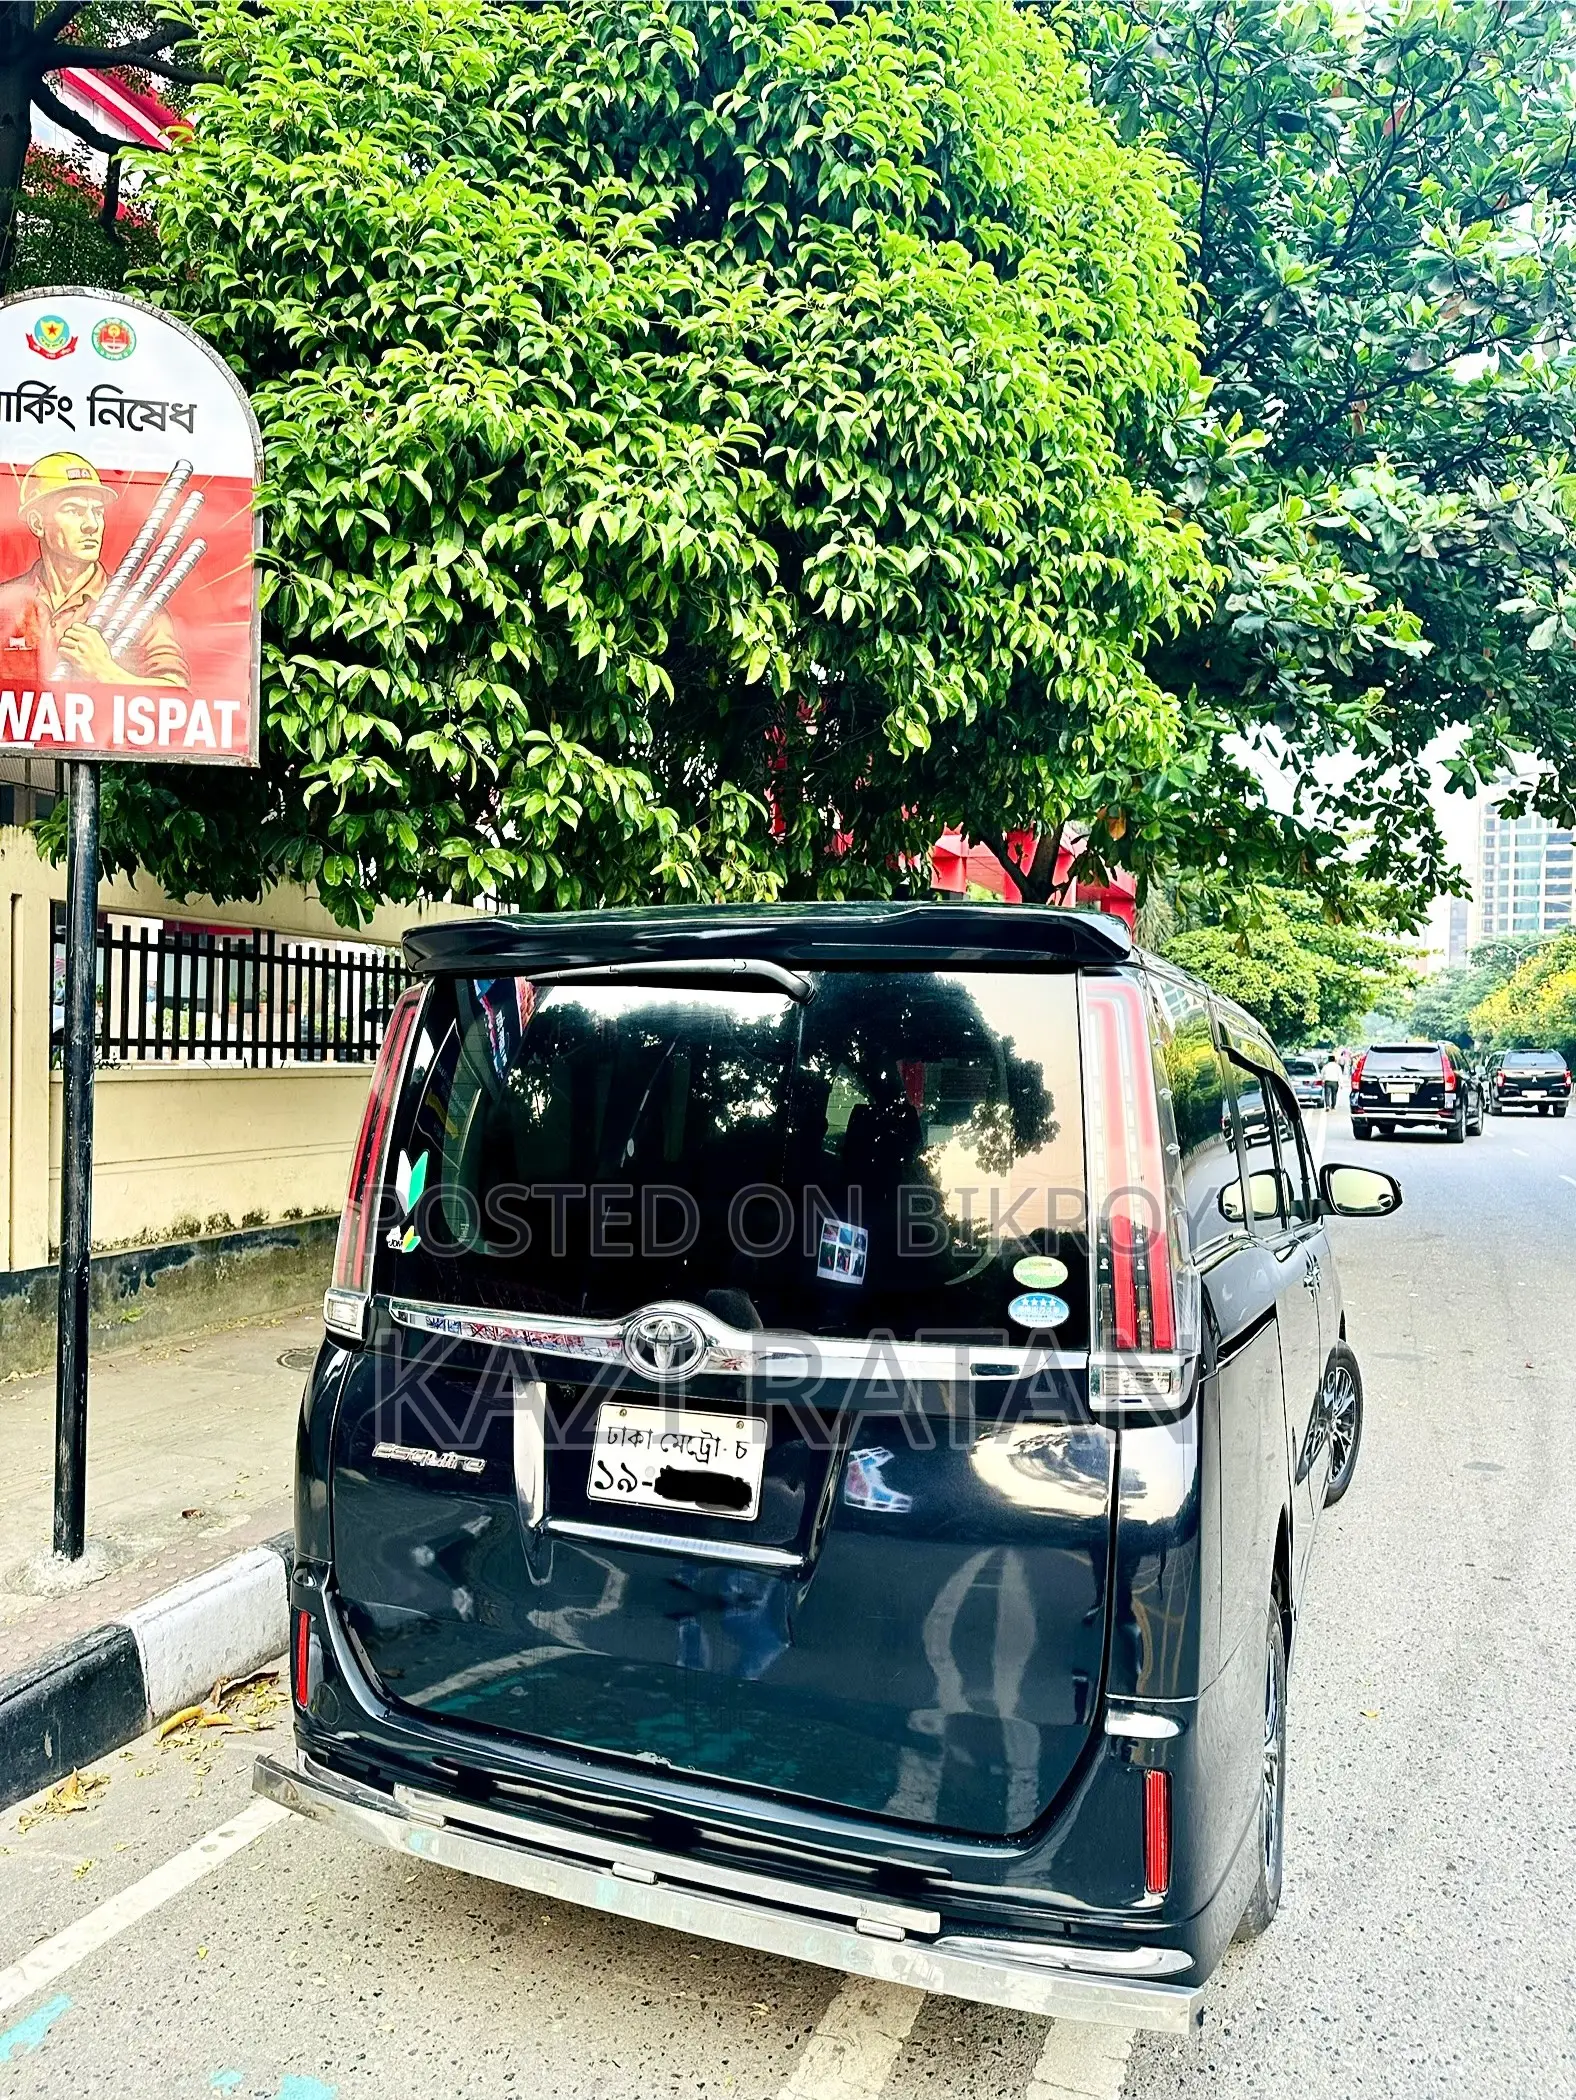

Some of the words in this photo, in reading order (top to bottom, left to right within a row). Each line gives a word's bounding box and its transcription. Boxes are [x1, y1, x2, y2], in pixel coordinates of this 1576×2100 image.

[0, 380, 76, 432] ার্কিং
[87, 384, 197, 434] নিষেধ
[112, 695, 241, 749] ISPAT
[607, 1426, 653, 1450] ঢাকা
